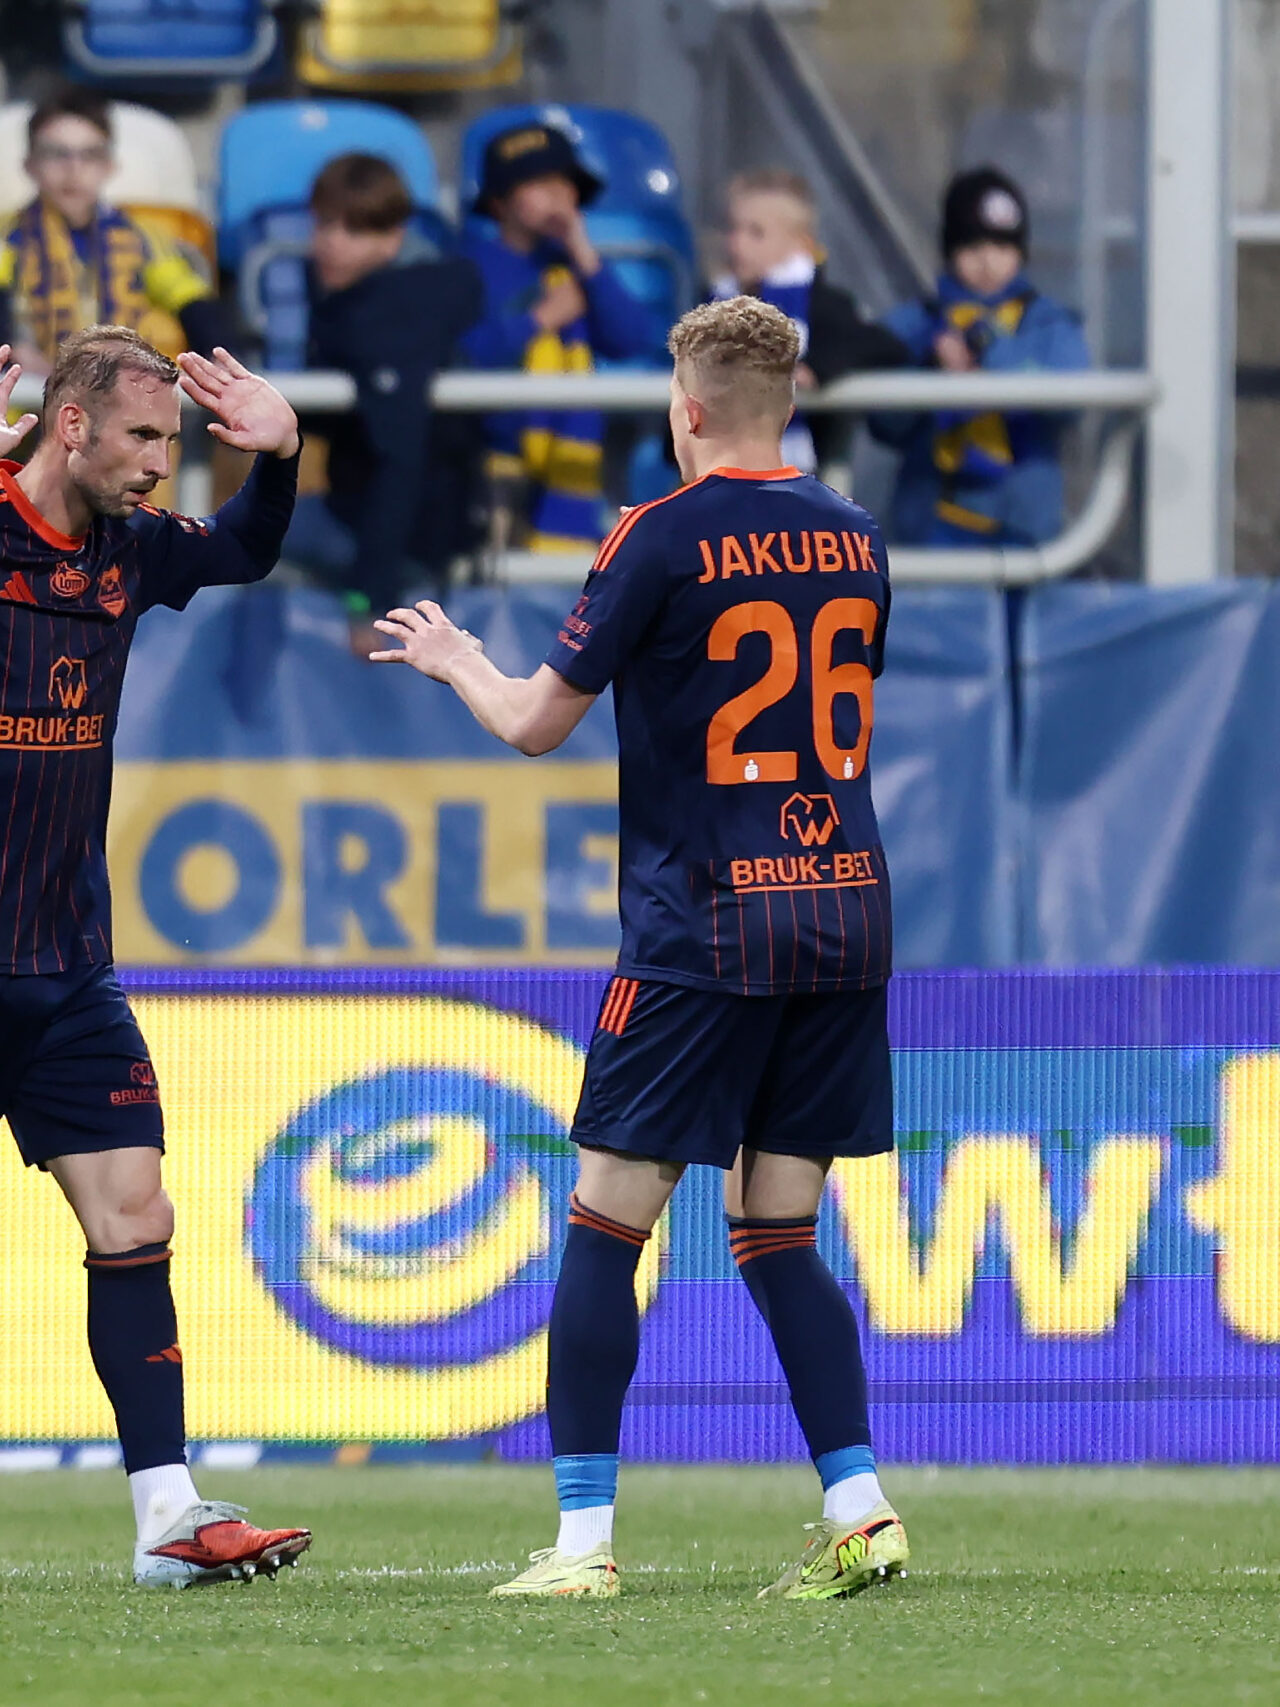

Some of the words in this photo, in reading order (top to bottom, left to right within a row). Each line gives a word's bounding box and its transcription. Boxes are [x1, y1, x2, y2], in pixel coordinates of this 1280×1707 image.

[697, 530, 878, 584] JAKUBIK
[706, 598, 879, 785] 26
[730, 852, 874, 888] BRUK-BET
